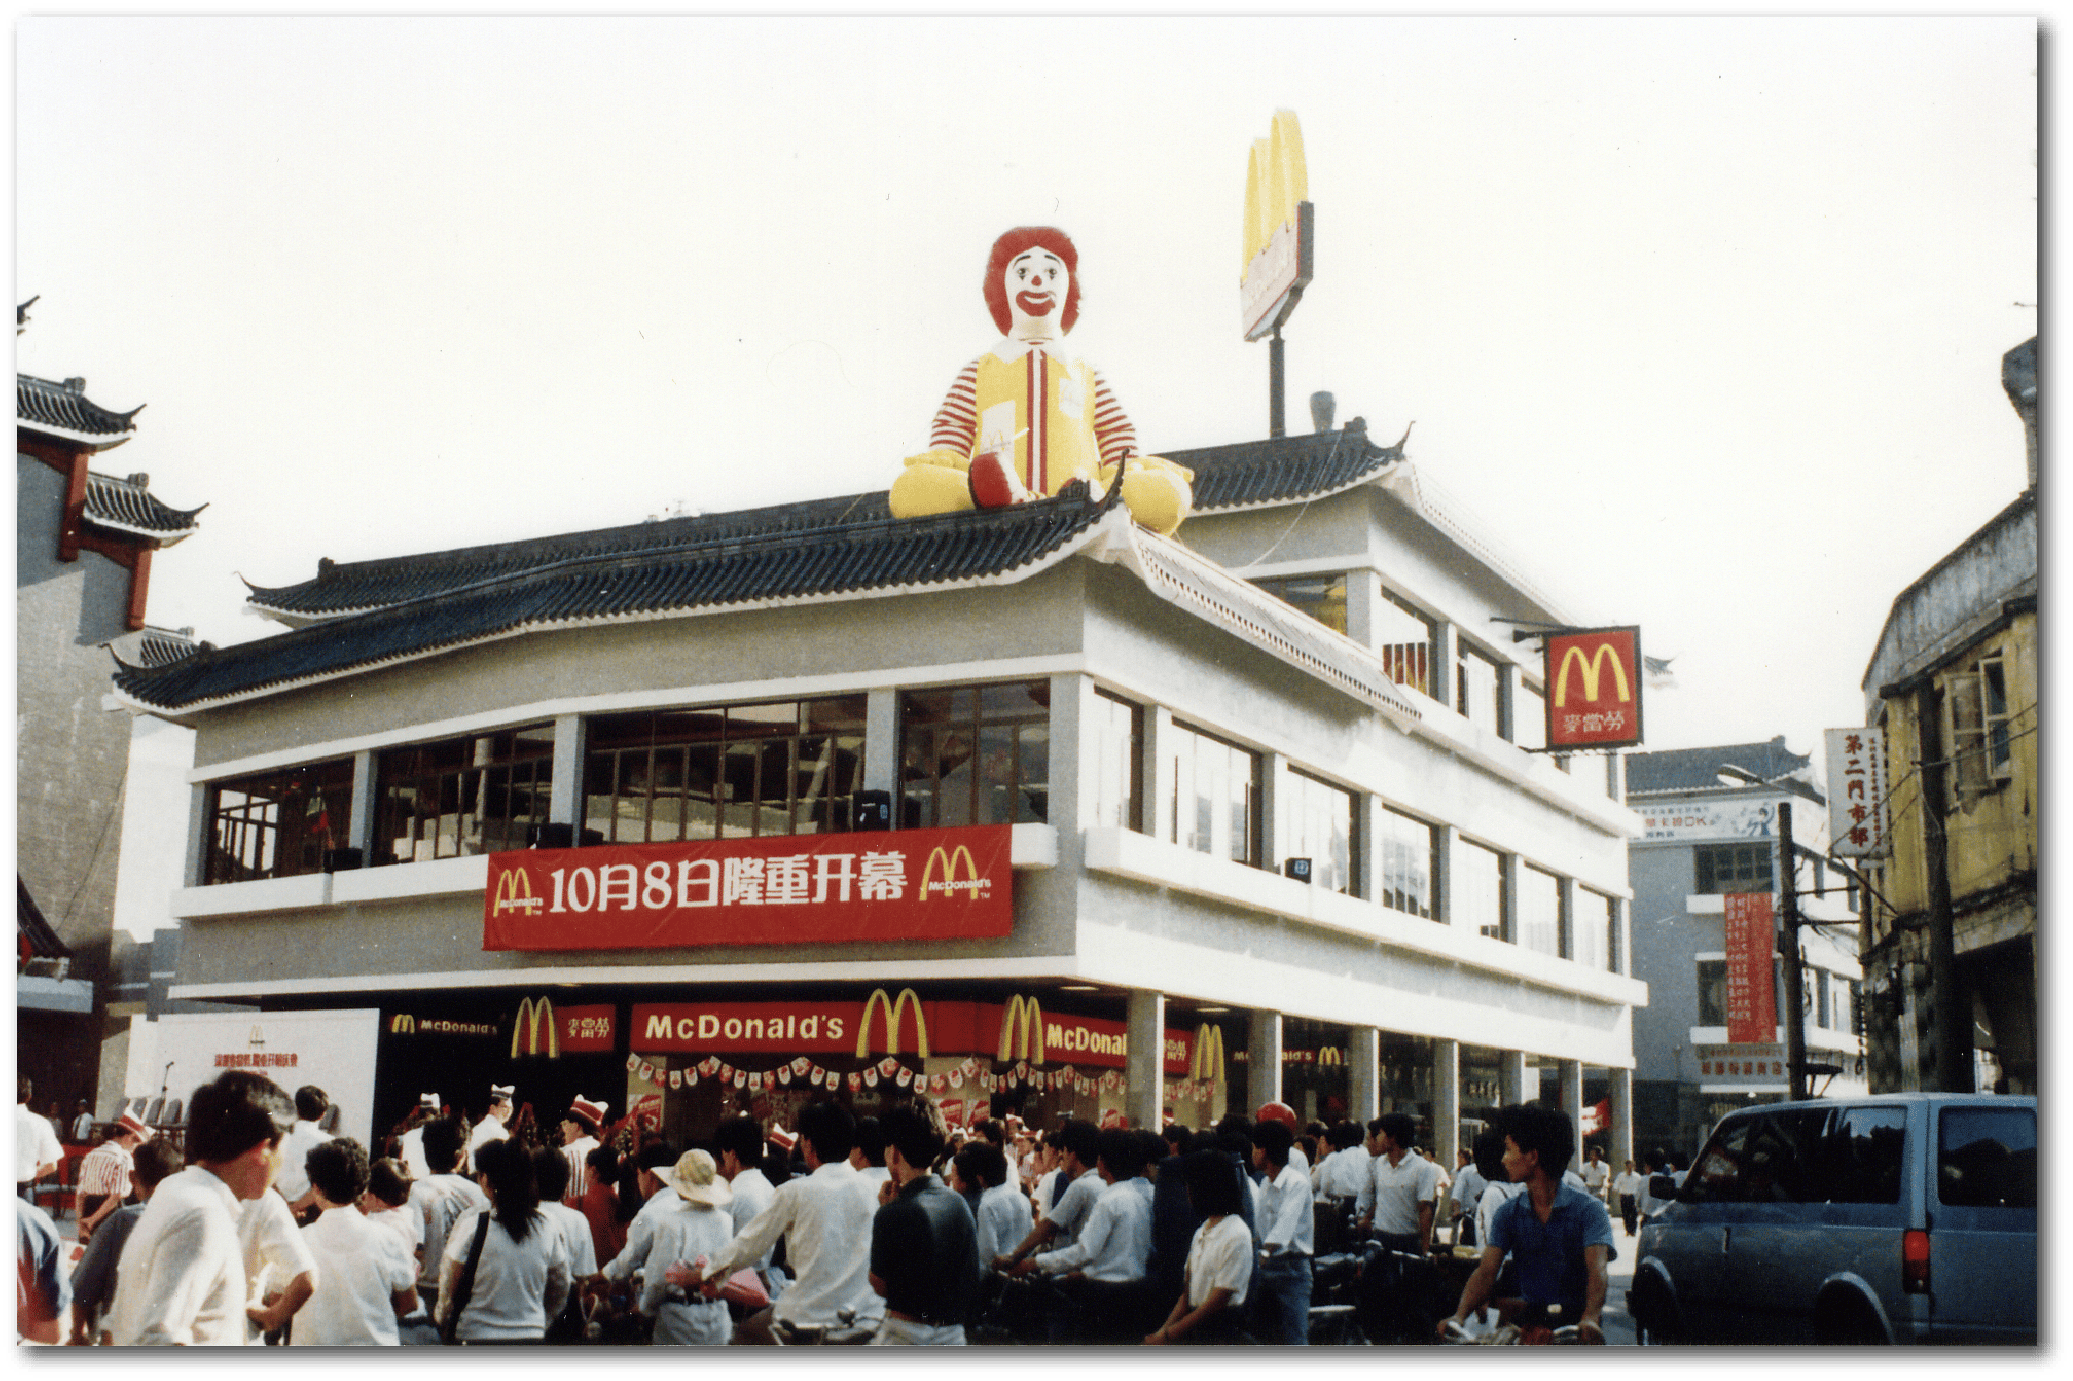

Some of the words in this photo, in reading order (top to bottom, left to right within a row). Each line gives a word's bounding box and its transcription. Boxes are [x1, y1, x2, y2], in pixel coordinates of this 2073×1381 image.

[1563, 711, 1625, 734] 麥當勞
[549, 851, 908, 913] 10月8日隆重开幕
[928, 877, 992, 891] McDonald's
[420, 1020, 498, 1036] McDonald's
[567, 1017, 610, 1039] 麥當勞
[645, 1014, 844, 1041] McDonald's
